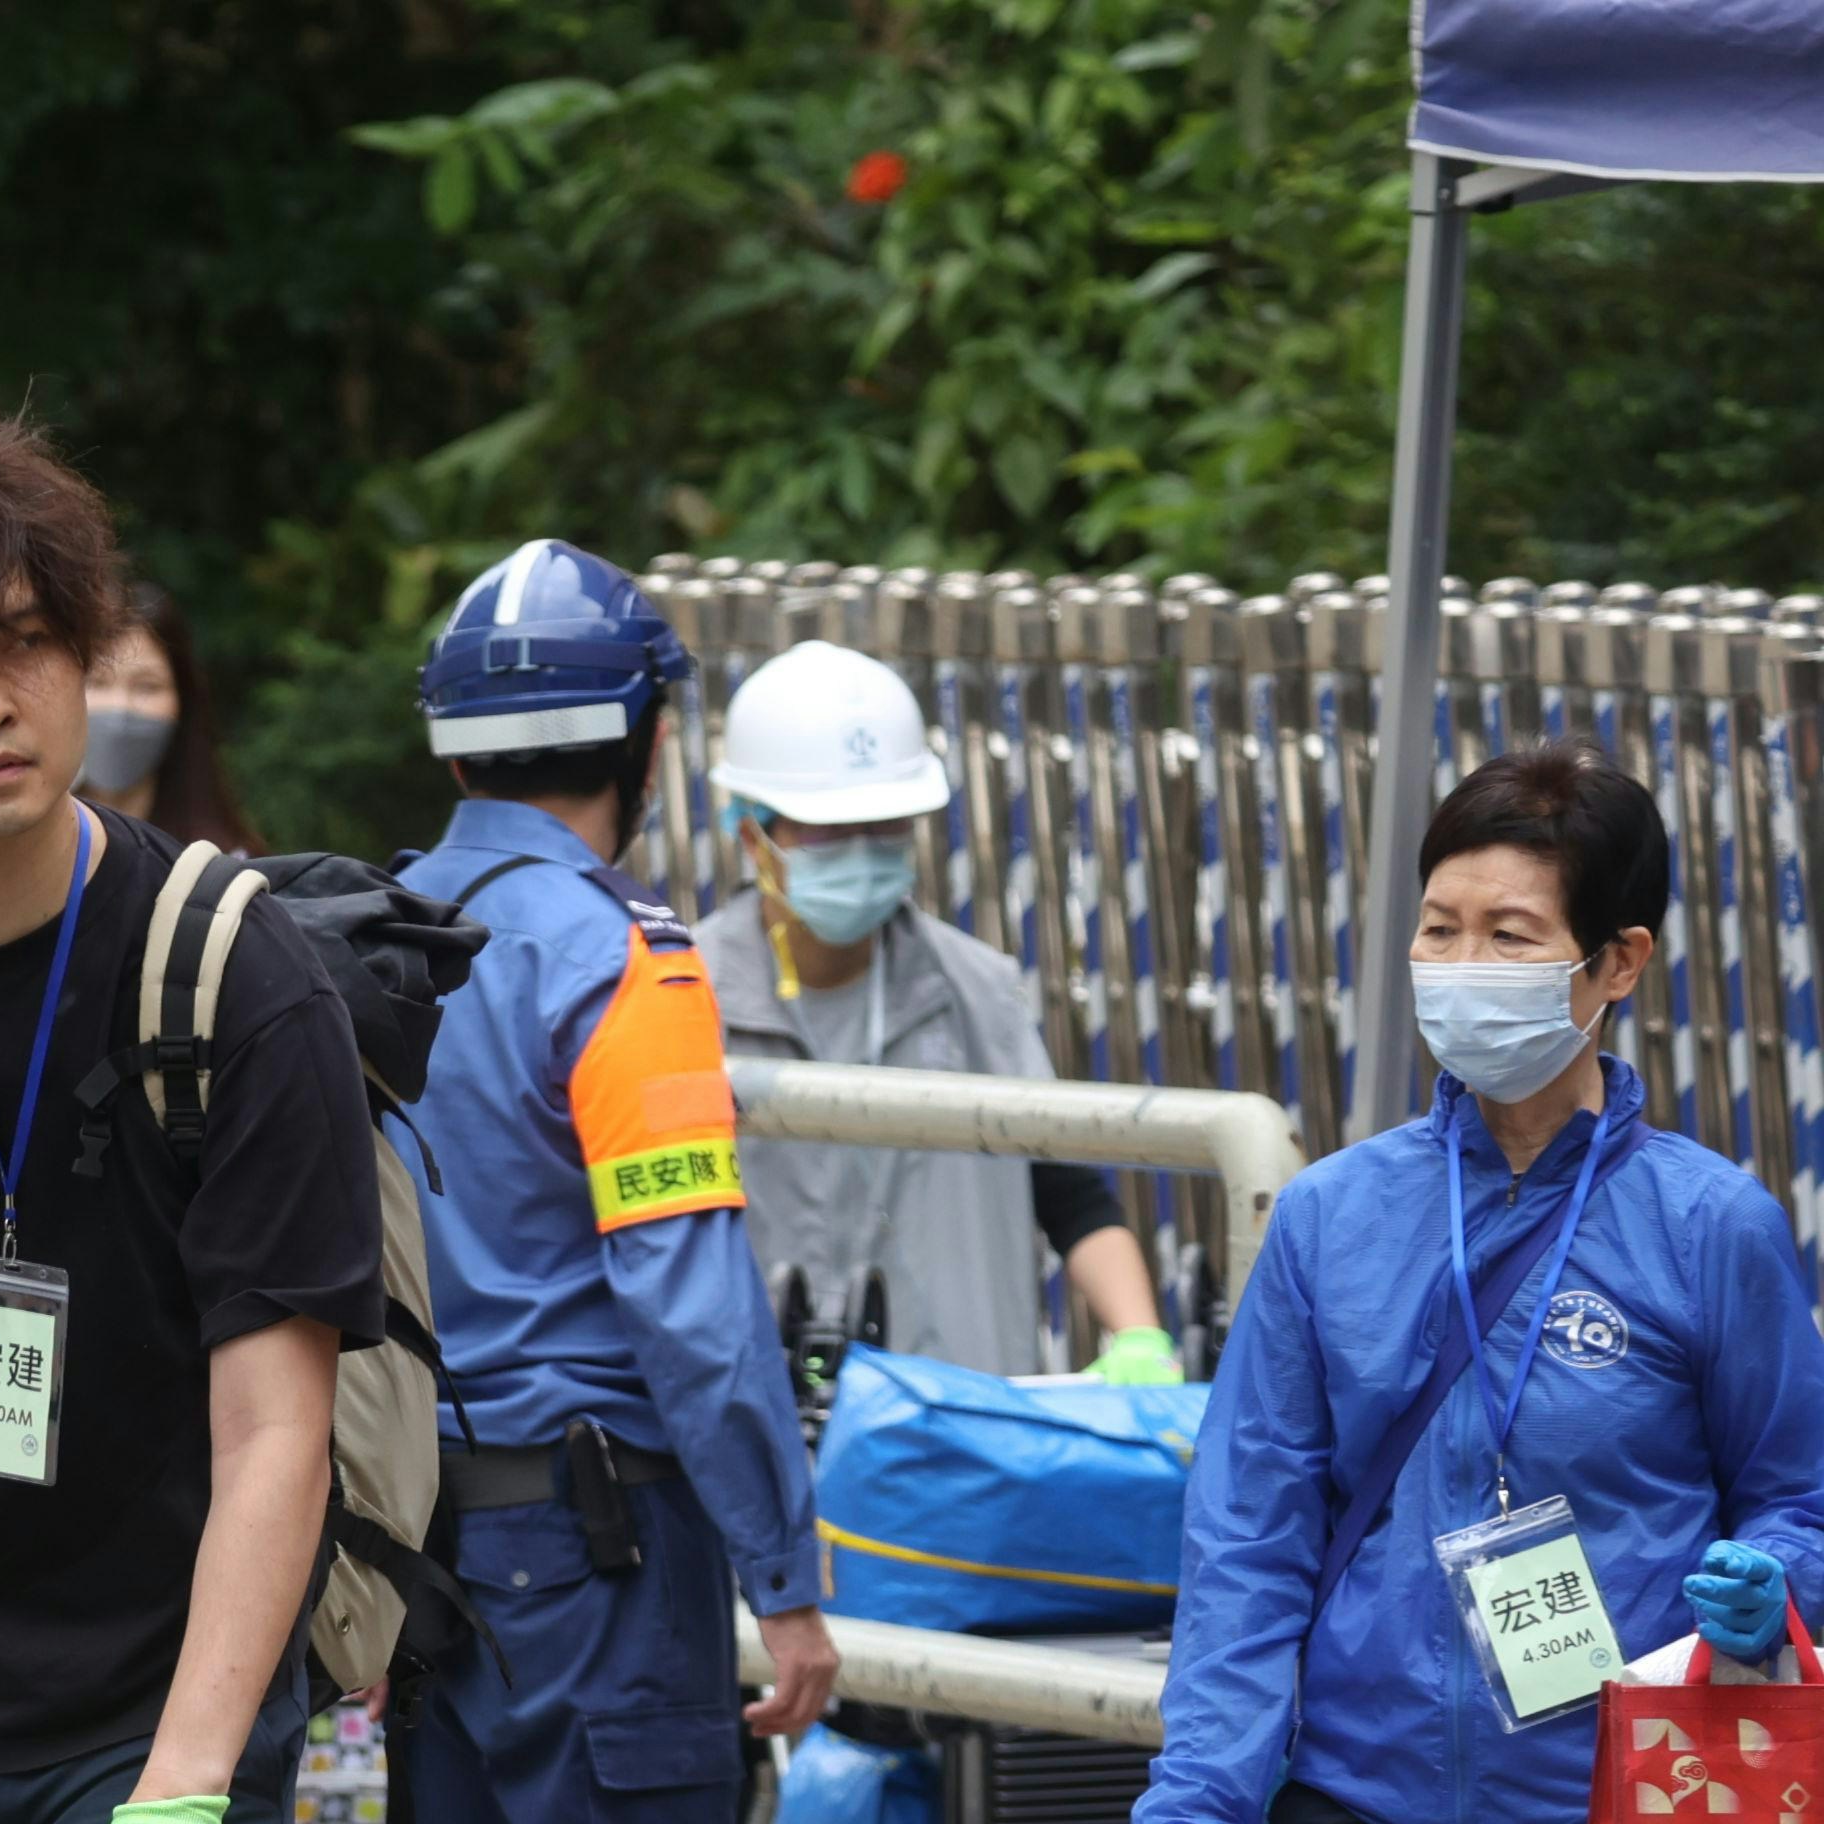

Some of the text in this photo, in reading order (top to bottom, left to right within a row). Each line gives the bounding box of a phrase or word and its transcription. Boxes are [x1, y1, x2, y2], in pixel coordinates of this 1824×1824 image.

[615, 1149, 719, 1201] 民安隊
[1490, 1571, 1591, 1634] 宏建
[1523, 1628, 1596, 1663] 4.30AM
